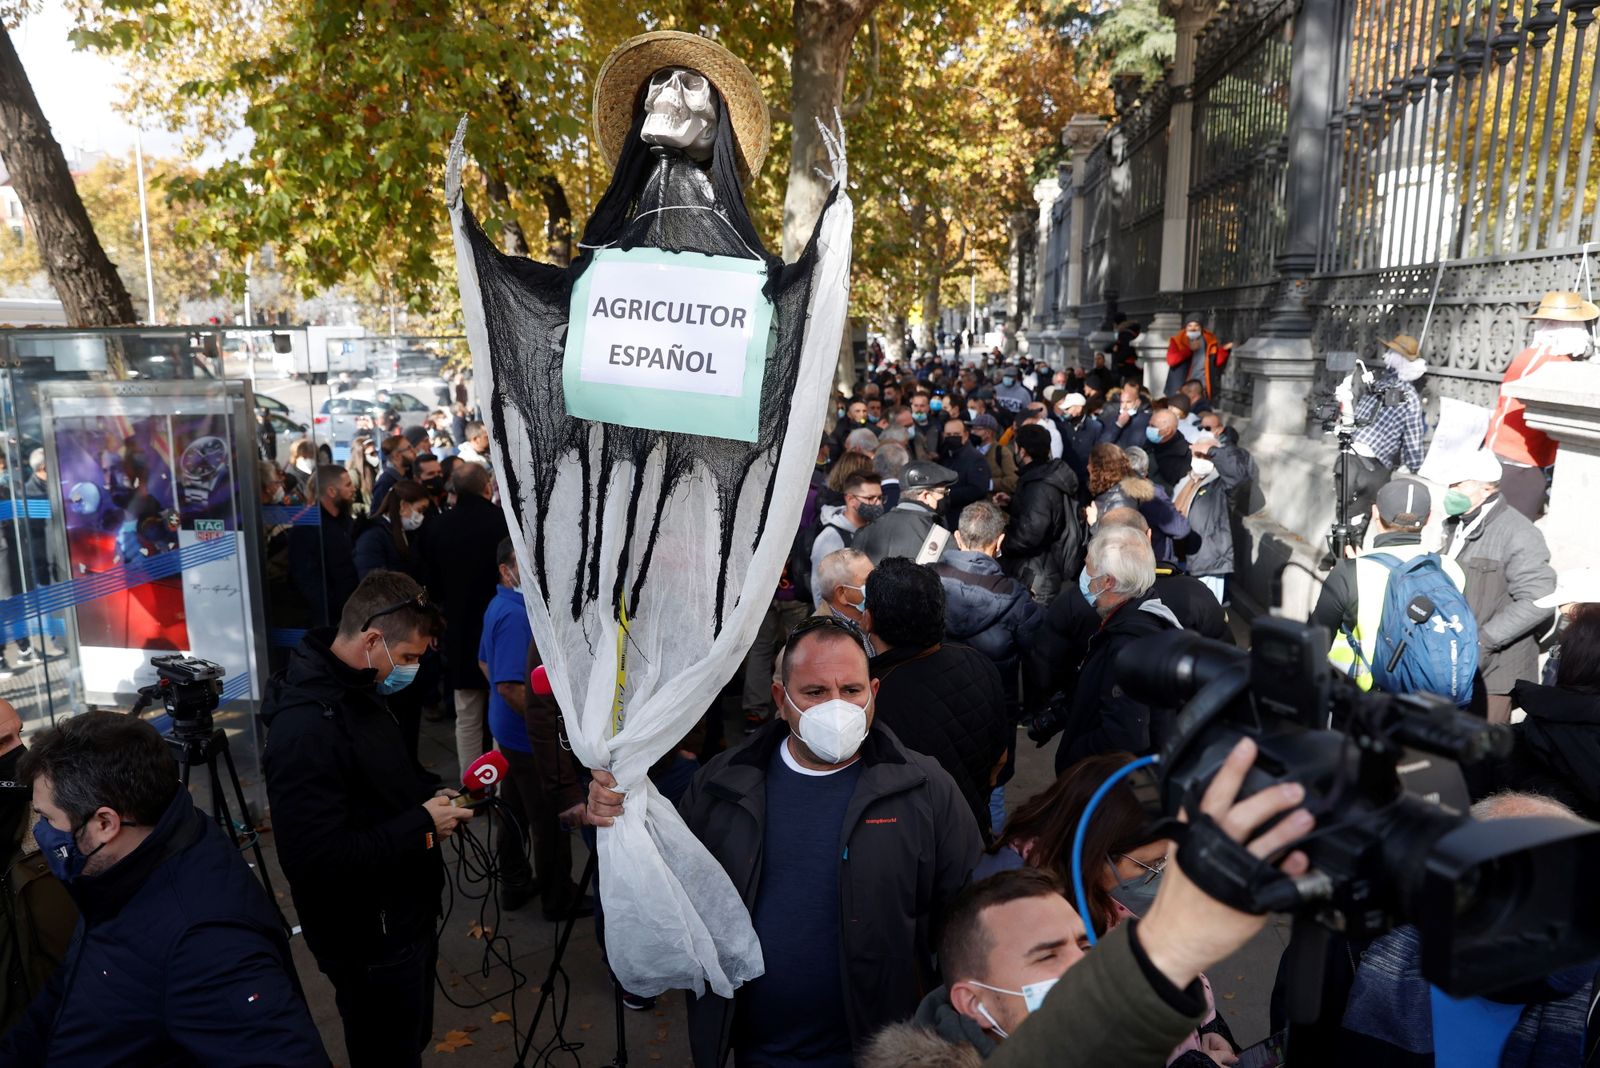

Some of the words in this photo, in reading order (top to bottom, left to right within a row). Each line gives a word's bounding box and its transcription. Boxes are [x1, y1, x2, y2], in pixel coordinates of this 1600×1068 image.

[592, 296, 747, 329] AGRICULTOR
[608, 343, 717, 375] ESPAÑOL
[198, 521, 222, 531] TAG
